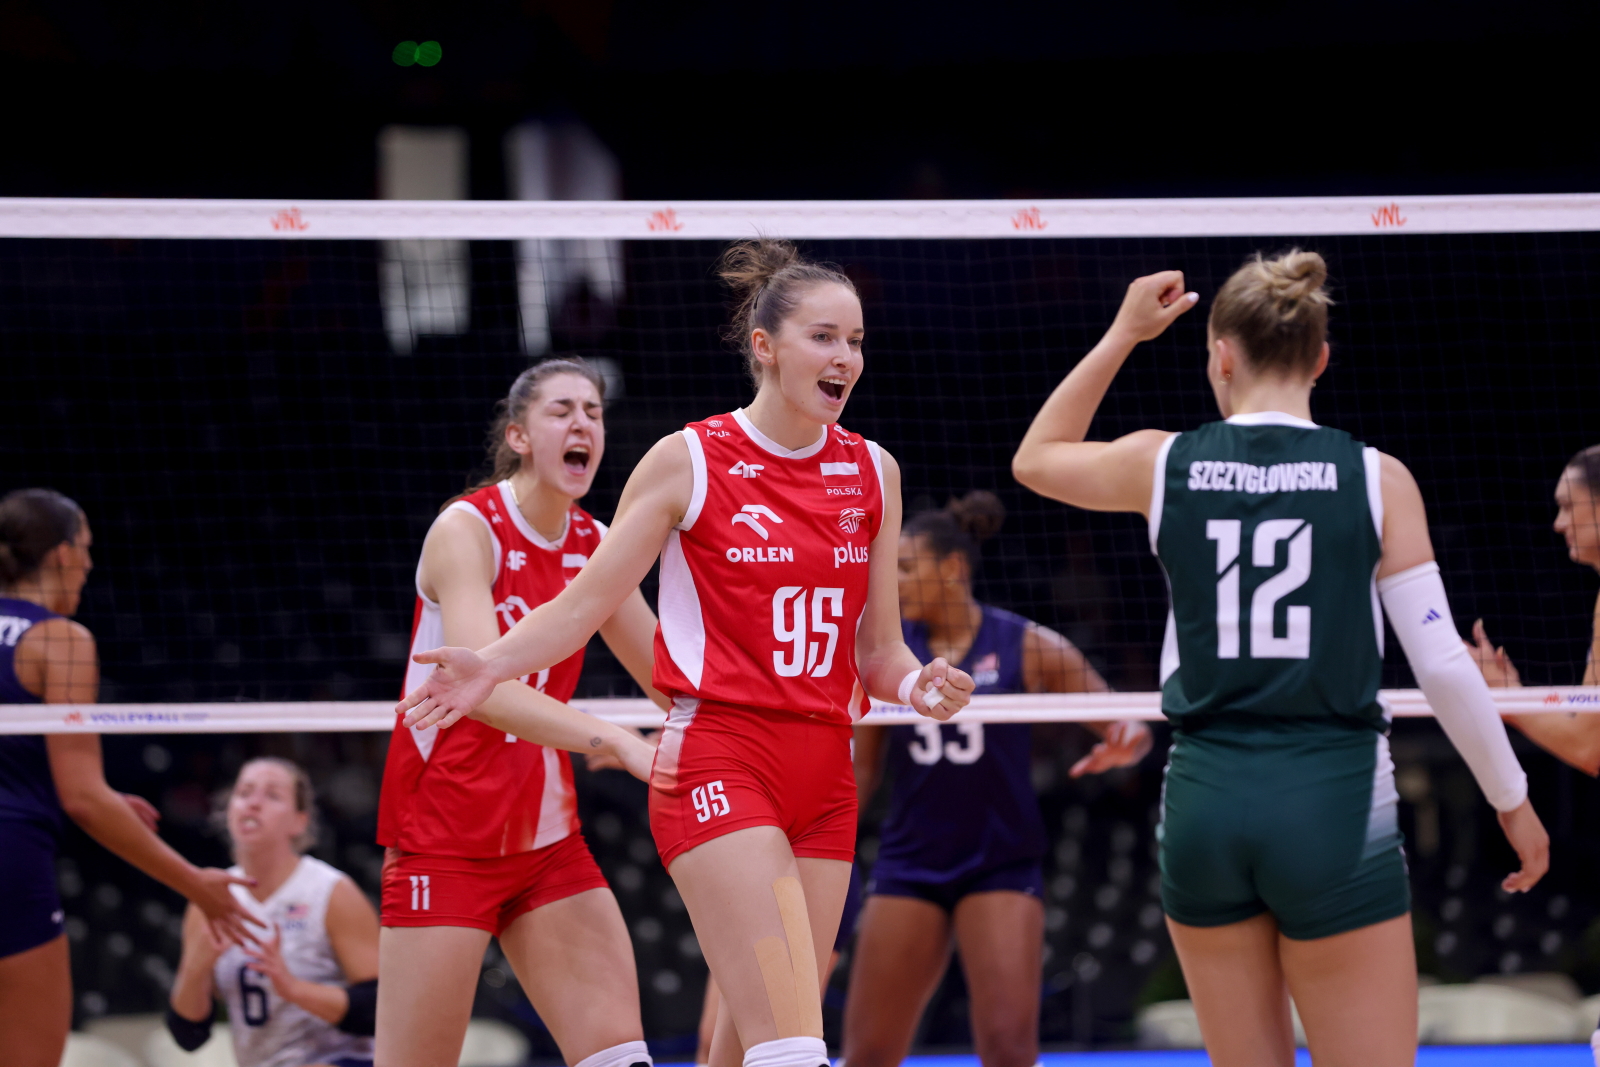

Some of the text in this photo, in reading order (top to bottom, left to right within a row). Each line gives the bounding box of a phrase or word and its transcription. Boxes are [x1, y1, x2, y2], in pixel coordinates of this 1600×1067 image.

[728, 460, 765, 479] 4F
[1187, 461, 1338, 494] SZCZYGŁOWSKA
[826, 487, 863, 496] POLSKA
[725, 547, 794, 563] ORLEN
[833, 541, 869, 569] plus
[1206, 518, 1313, 659] 12
[772, 585, 845, 678] 95
[907, 722, 985, 765] 33
[691, 780, 731, 823] 95
[409, 875, 431, 911] 11
[238, 963, 269, 1028] 6
